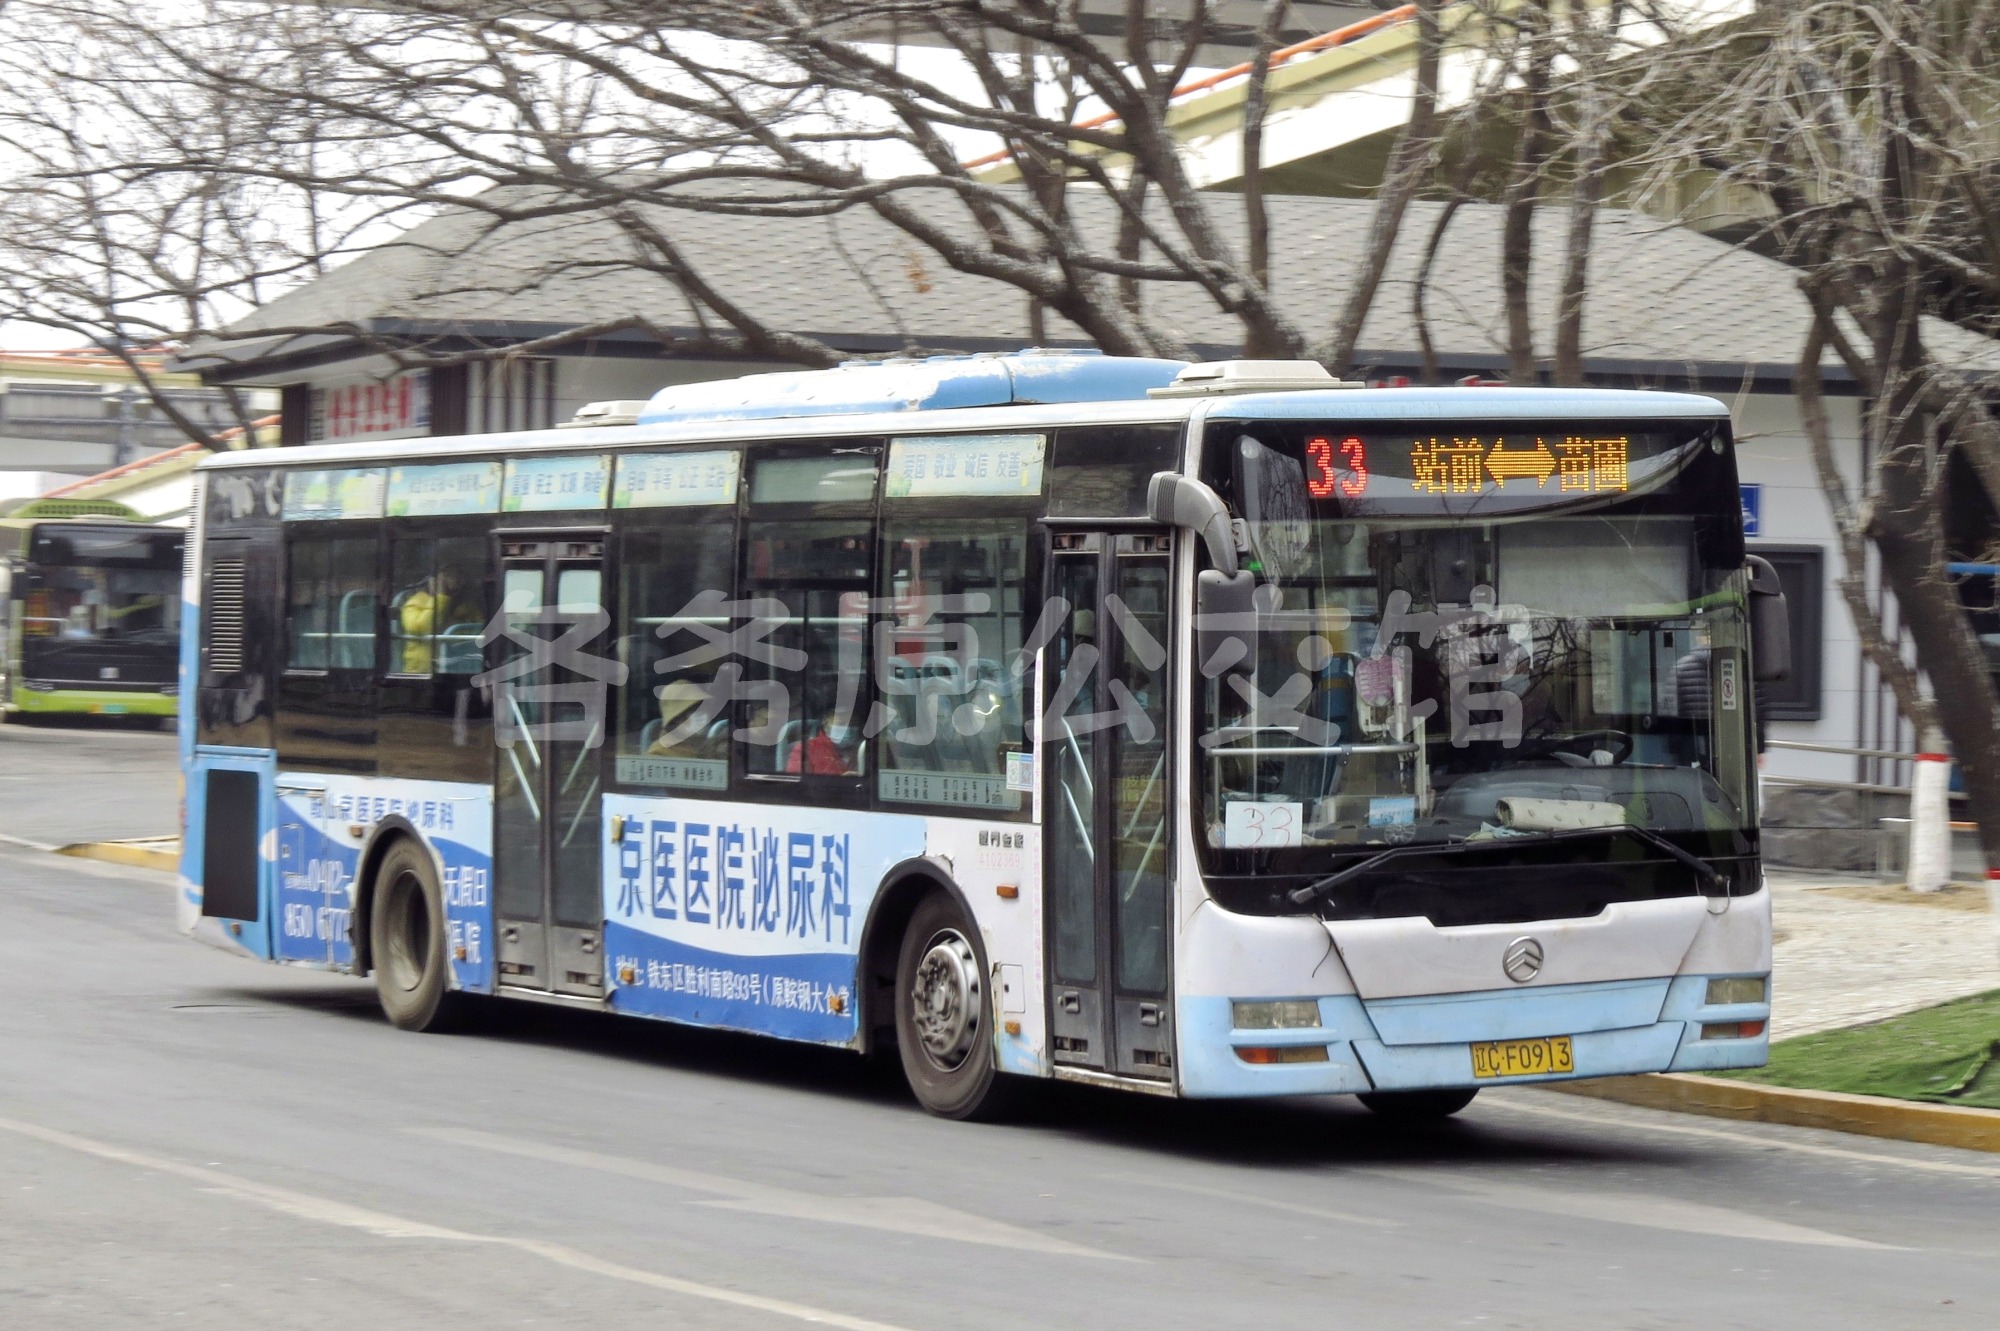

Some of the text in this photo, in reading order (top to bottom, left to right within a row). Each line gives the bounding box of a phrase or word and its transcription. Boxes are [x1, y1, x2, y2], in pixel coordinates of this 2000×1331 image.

[996, 450, 1022, 478] 友善
[1308, 438, 1368, 494] 33
[1411, 437, 1484, 493] 站前
[1240, 806, 1292, 848] 33
[617, 814, 852, 945] 京医医院泌尿科
[1475, 1041, 1571, 1072] 辽C·F0913
